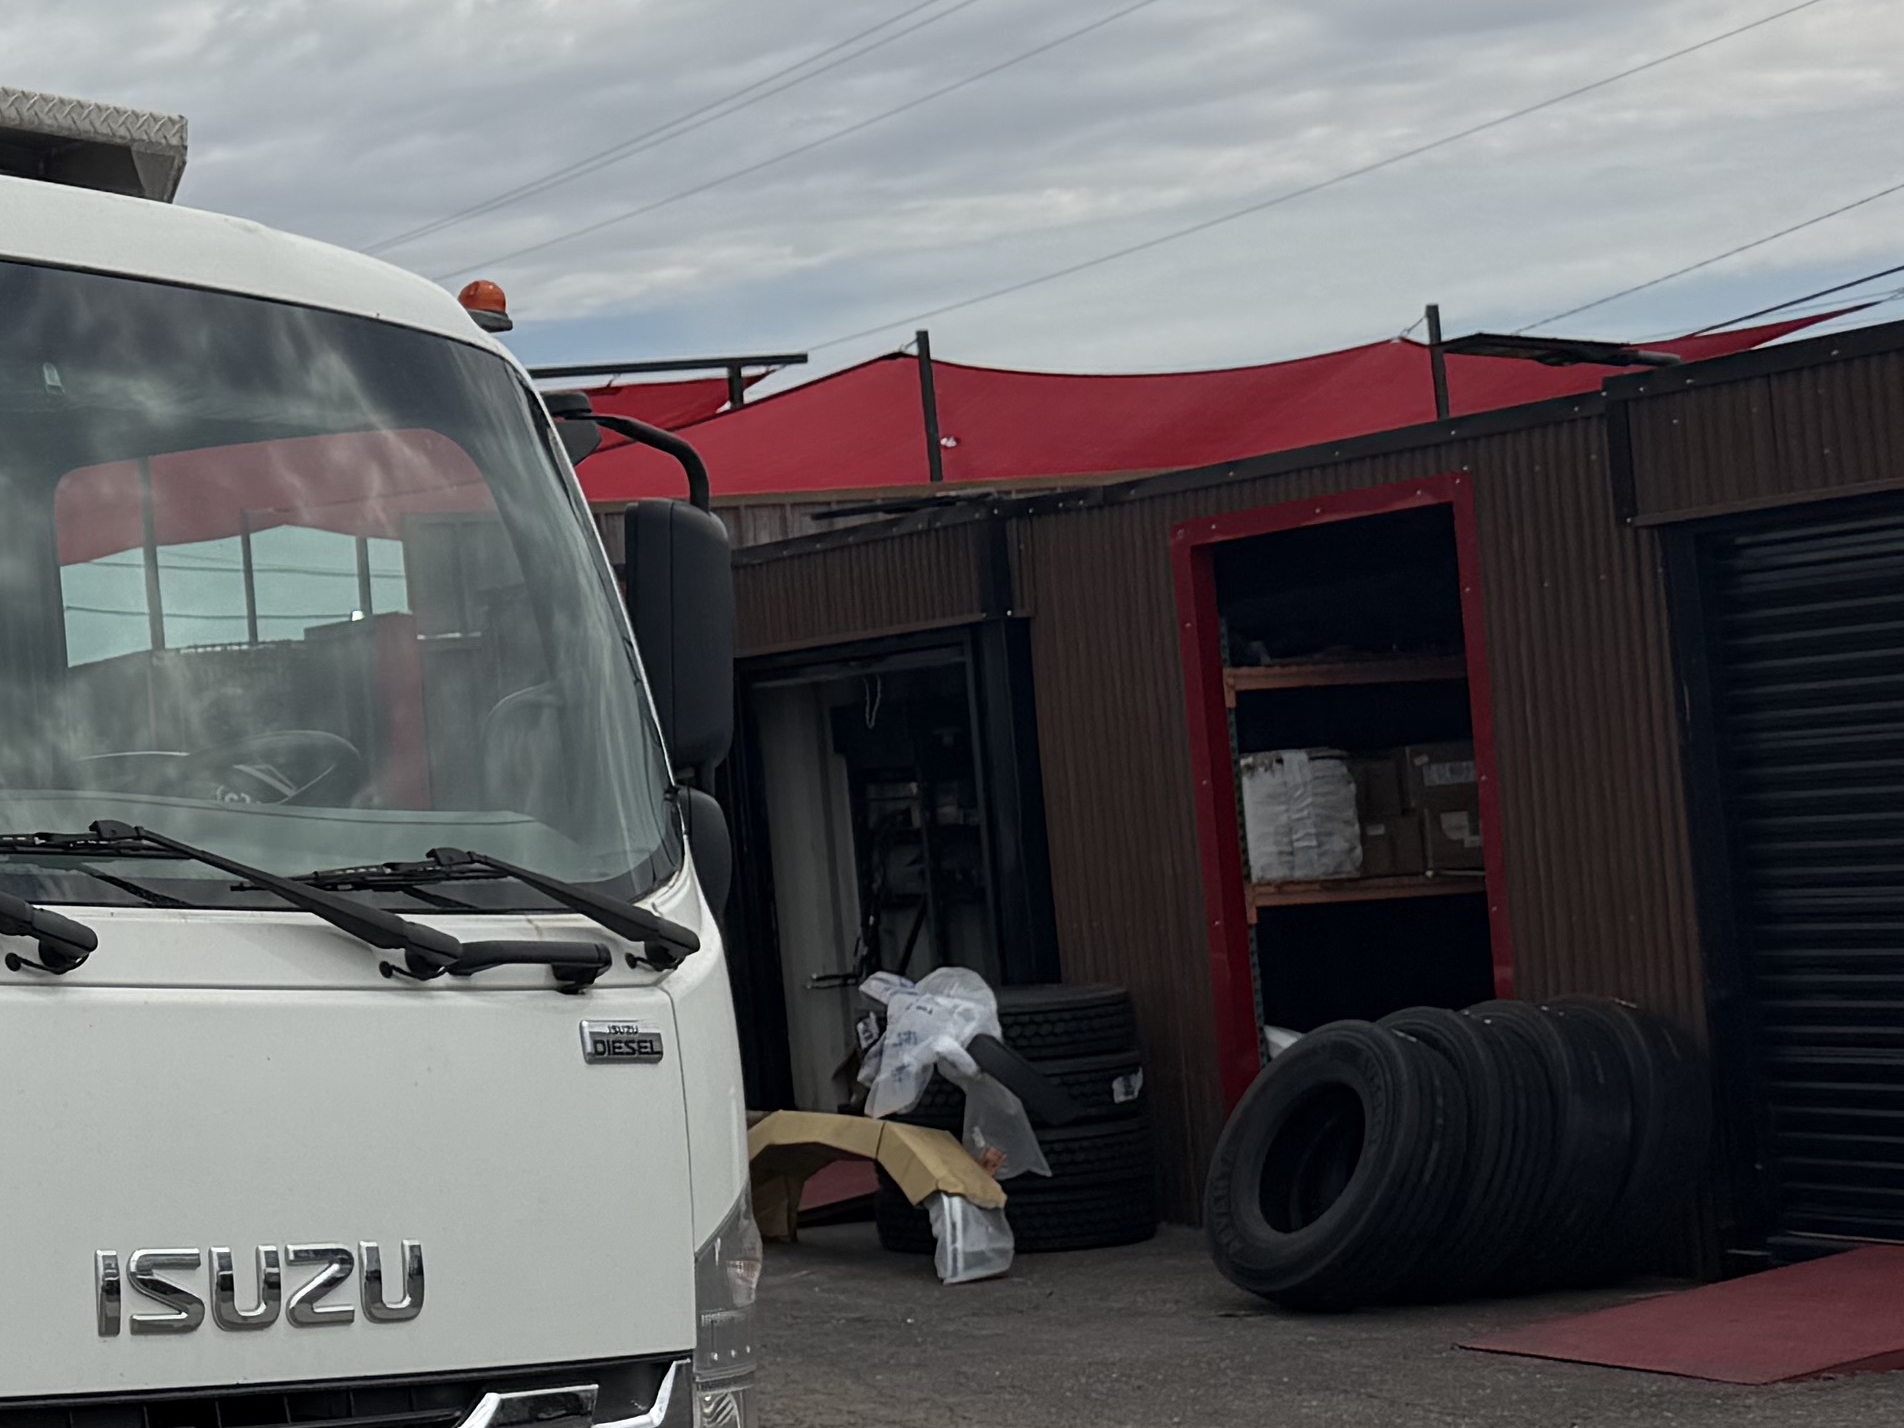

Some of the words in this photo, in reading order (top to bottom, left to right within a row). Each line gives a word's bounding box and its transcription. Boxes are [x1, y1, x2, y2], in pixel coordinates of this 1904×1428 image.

[607, 1024, 639, 1035] ISUZU
[593, 1038, 664, 1057] DIESEL
[94, 1238, 426, 1338] ISUZU
